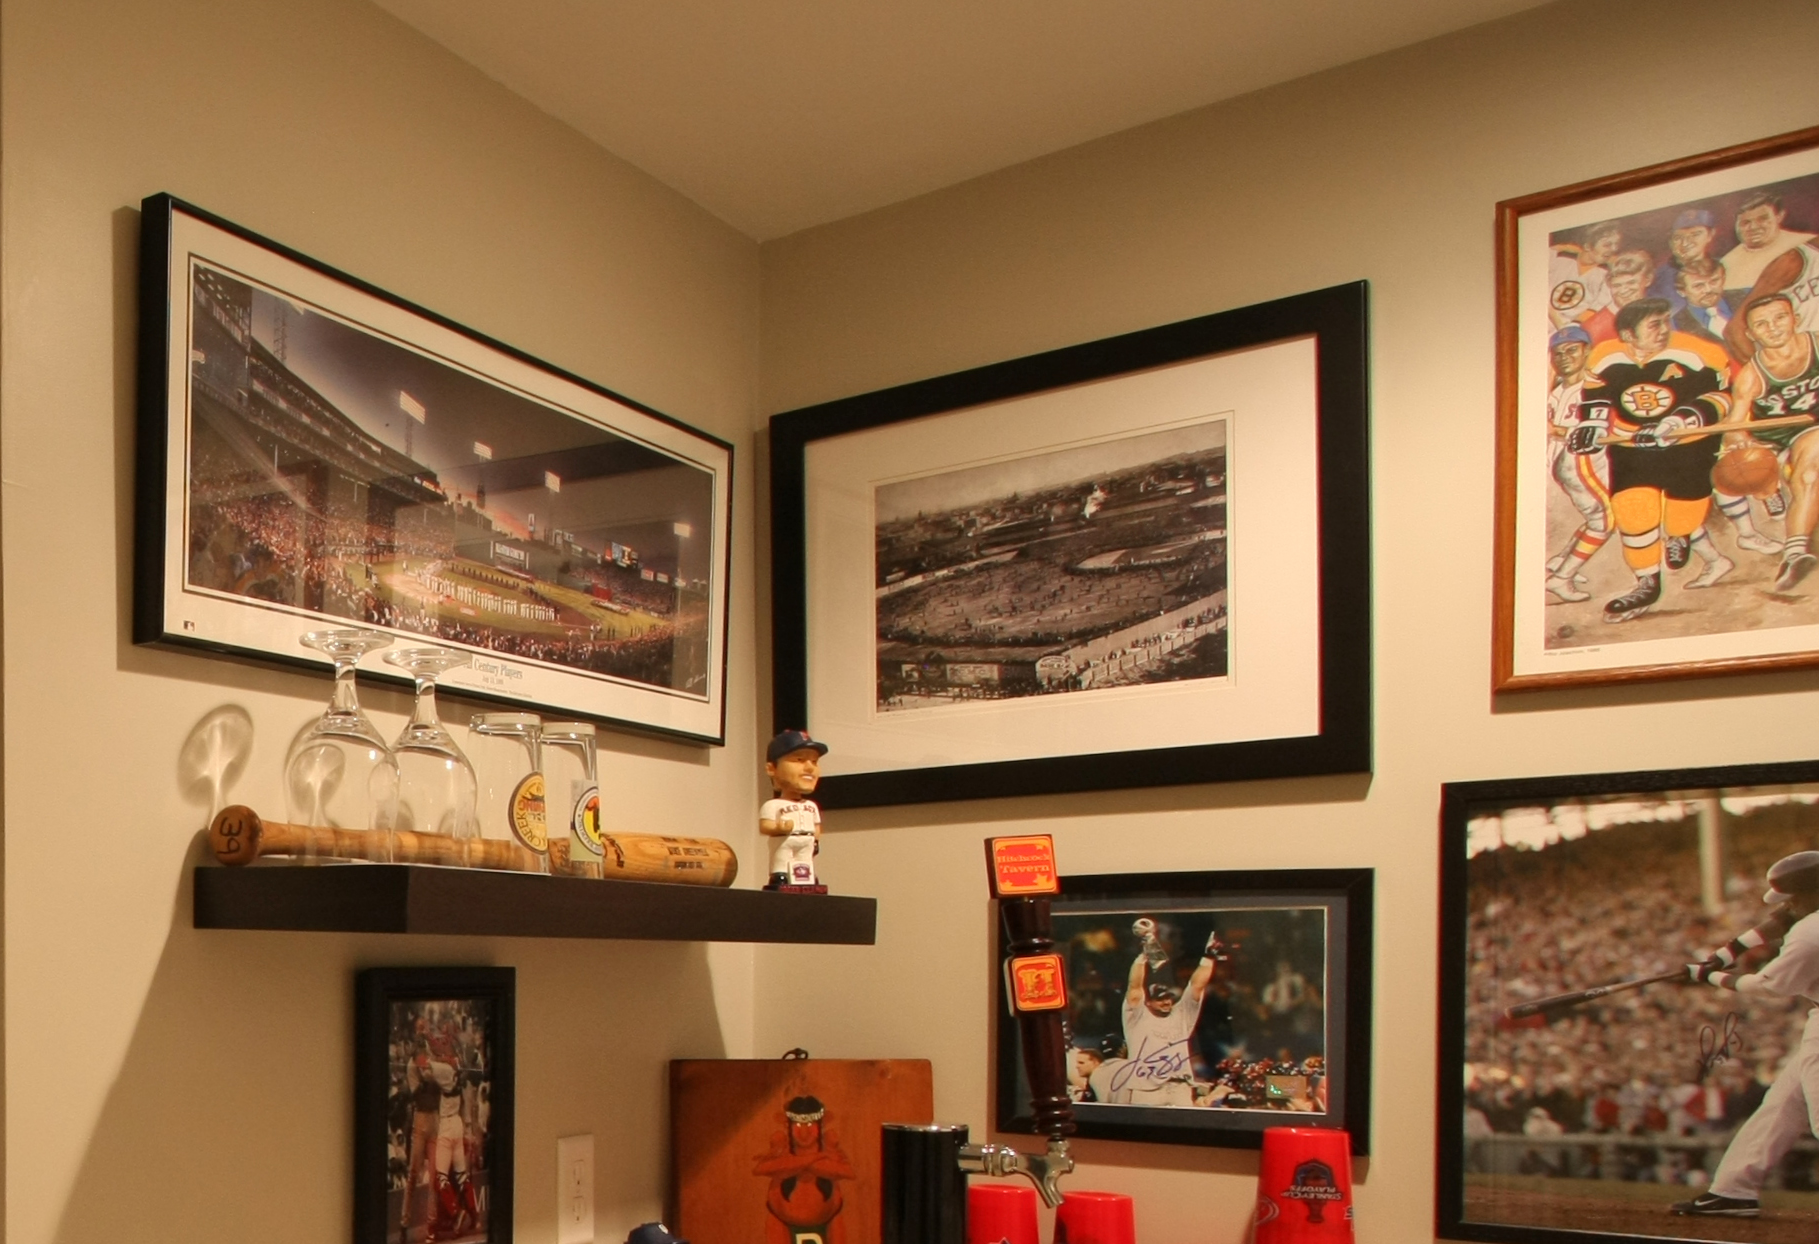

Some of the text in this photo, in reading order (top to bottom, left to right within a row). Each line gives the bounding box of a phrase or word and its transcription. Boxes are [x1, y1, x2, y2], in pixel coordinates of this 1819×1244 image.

[1792, 276, 1819, 303] CE
[1756, 376, 1819, 406] BOSTO
[474, 658, 499, 677] Century
[500, 663, 523, 680] Players
[216, 817, 243, 855] 39
[997, 853, 1051, 864] Hitchcock
[1000, 863, 1051, 875] Tavern
